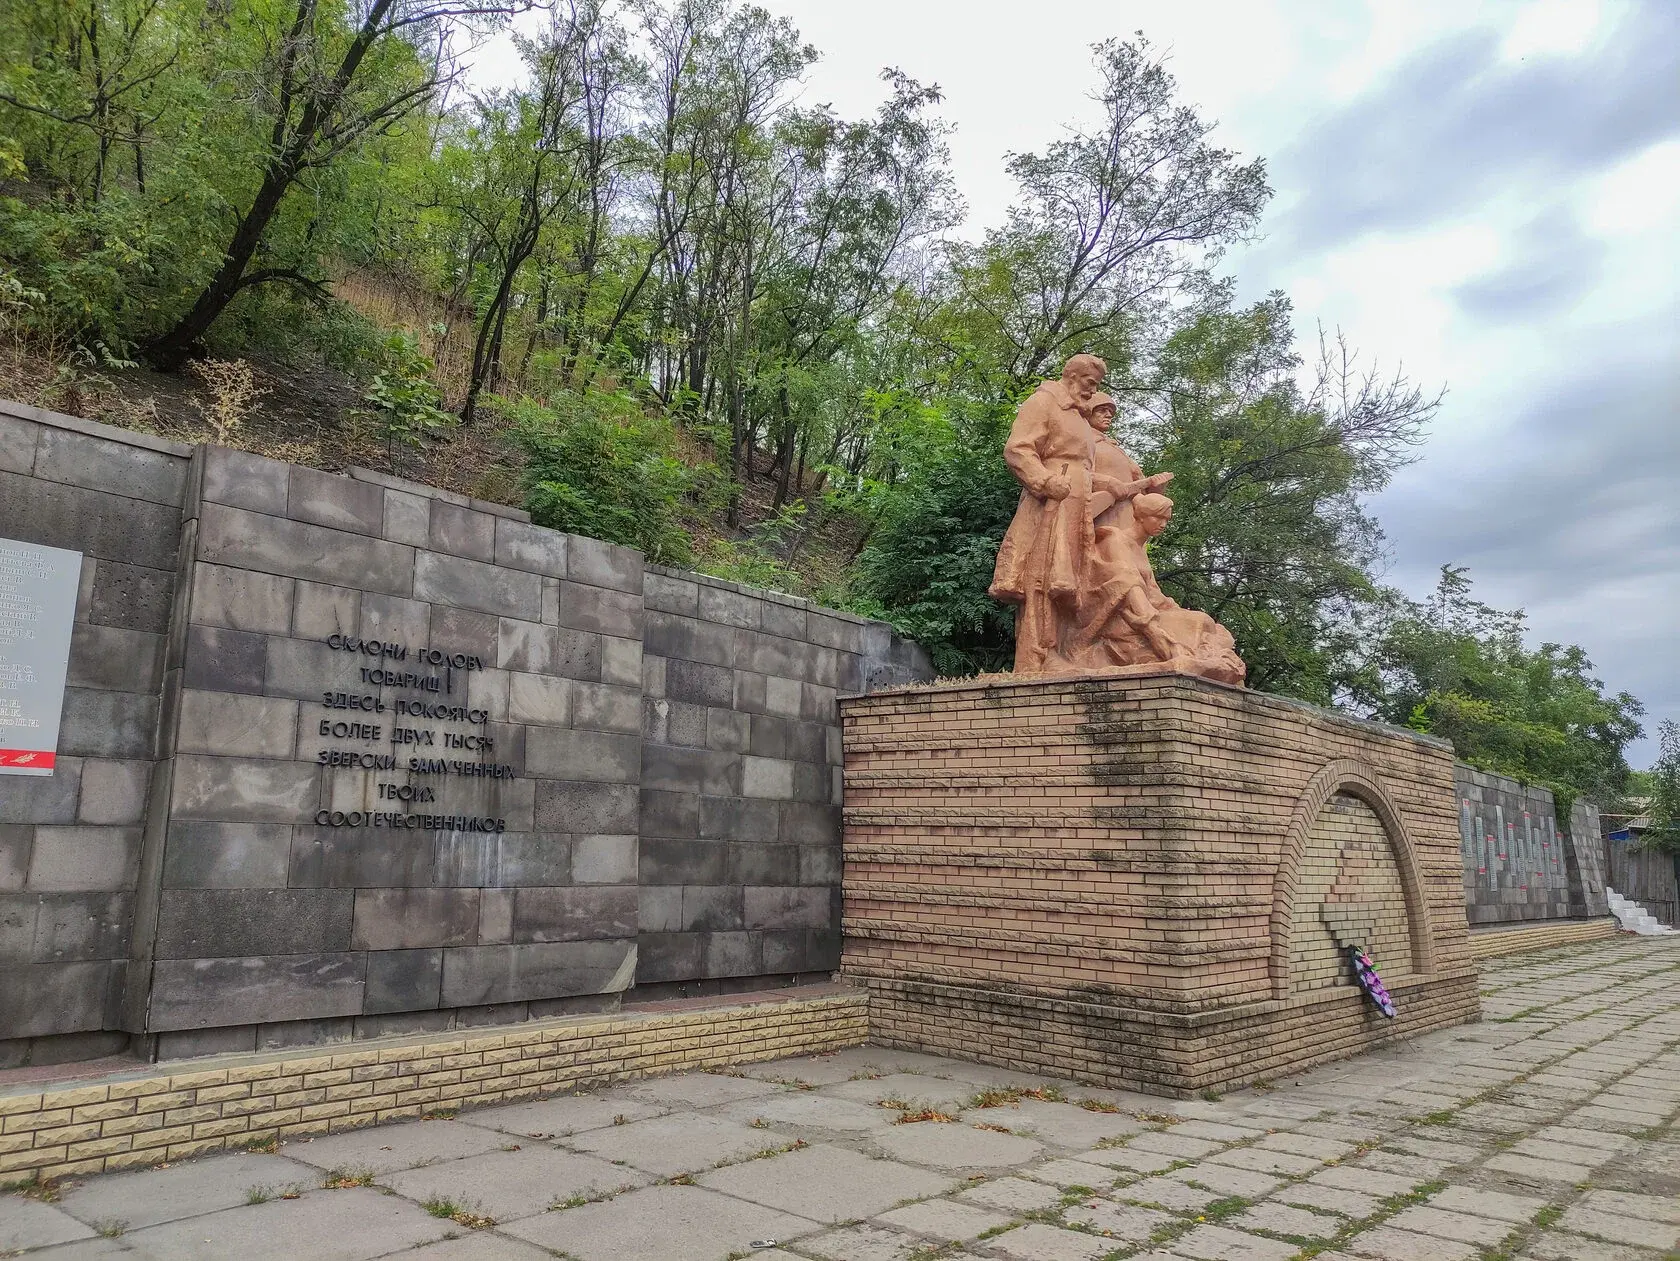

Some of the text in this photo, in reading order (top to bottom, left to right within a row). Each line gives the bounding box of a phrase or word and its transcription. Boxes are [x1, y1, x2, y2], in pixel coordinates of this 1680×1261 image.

[327, 634, 487, 672] СКЛОНИ ГОЛОВУ
[322, 692, 489, 725] ЗДЕСЬ ПОКОЯТСЯ
[319, 719, 494, 751] БОЛЕЕ ДВУХ ТЫСЯЧ
[317, 750, 516, 780] ЗВЕРСКИ ЗАМУЧЕННЫХ
[378, 783, 436, 803] ТВОИХ
[314, 809, 506, 834] СООТЕЧЕСТВЕННИКОВ
